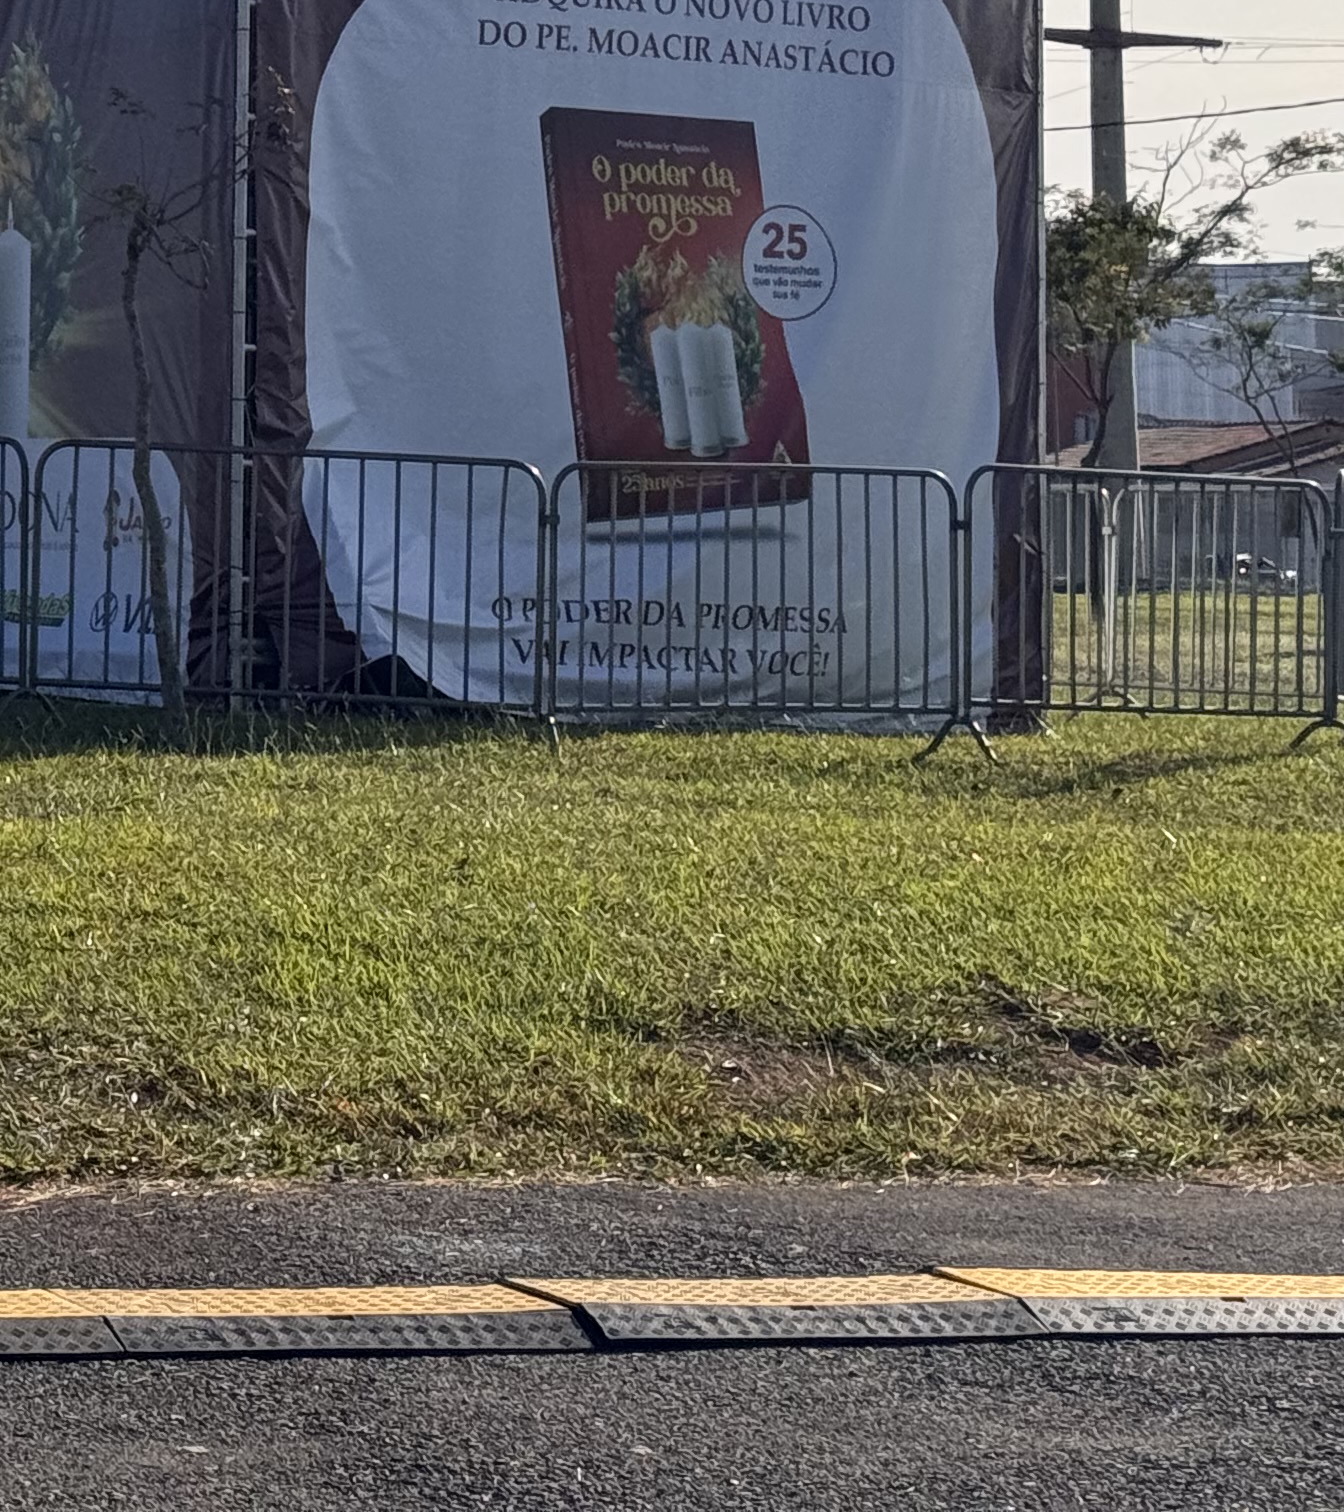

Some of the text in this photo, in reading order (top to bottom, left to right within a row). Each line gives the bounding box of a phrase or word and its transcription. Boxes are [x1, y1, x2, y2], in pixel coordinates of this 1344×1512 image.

[781, 0, 871, 33] LIVRO
[478, 19, 895, 78] DO PE. MOACIR ANASTÁCIO
[592, 155, 741, 197] O poder da
[603, 191, 733, 242] promessa
[762, 222, 807, 260] 25
[492, 597, 512, 621] O
[642, 599, 686, 628] DA
[578, 640, 737, 674] MPACTAR
